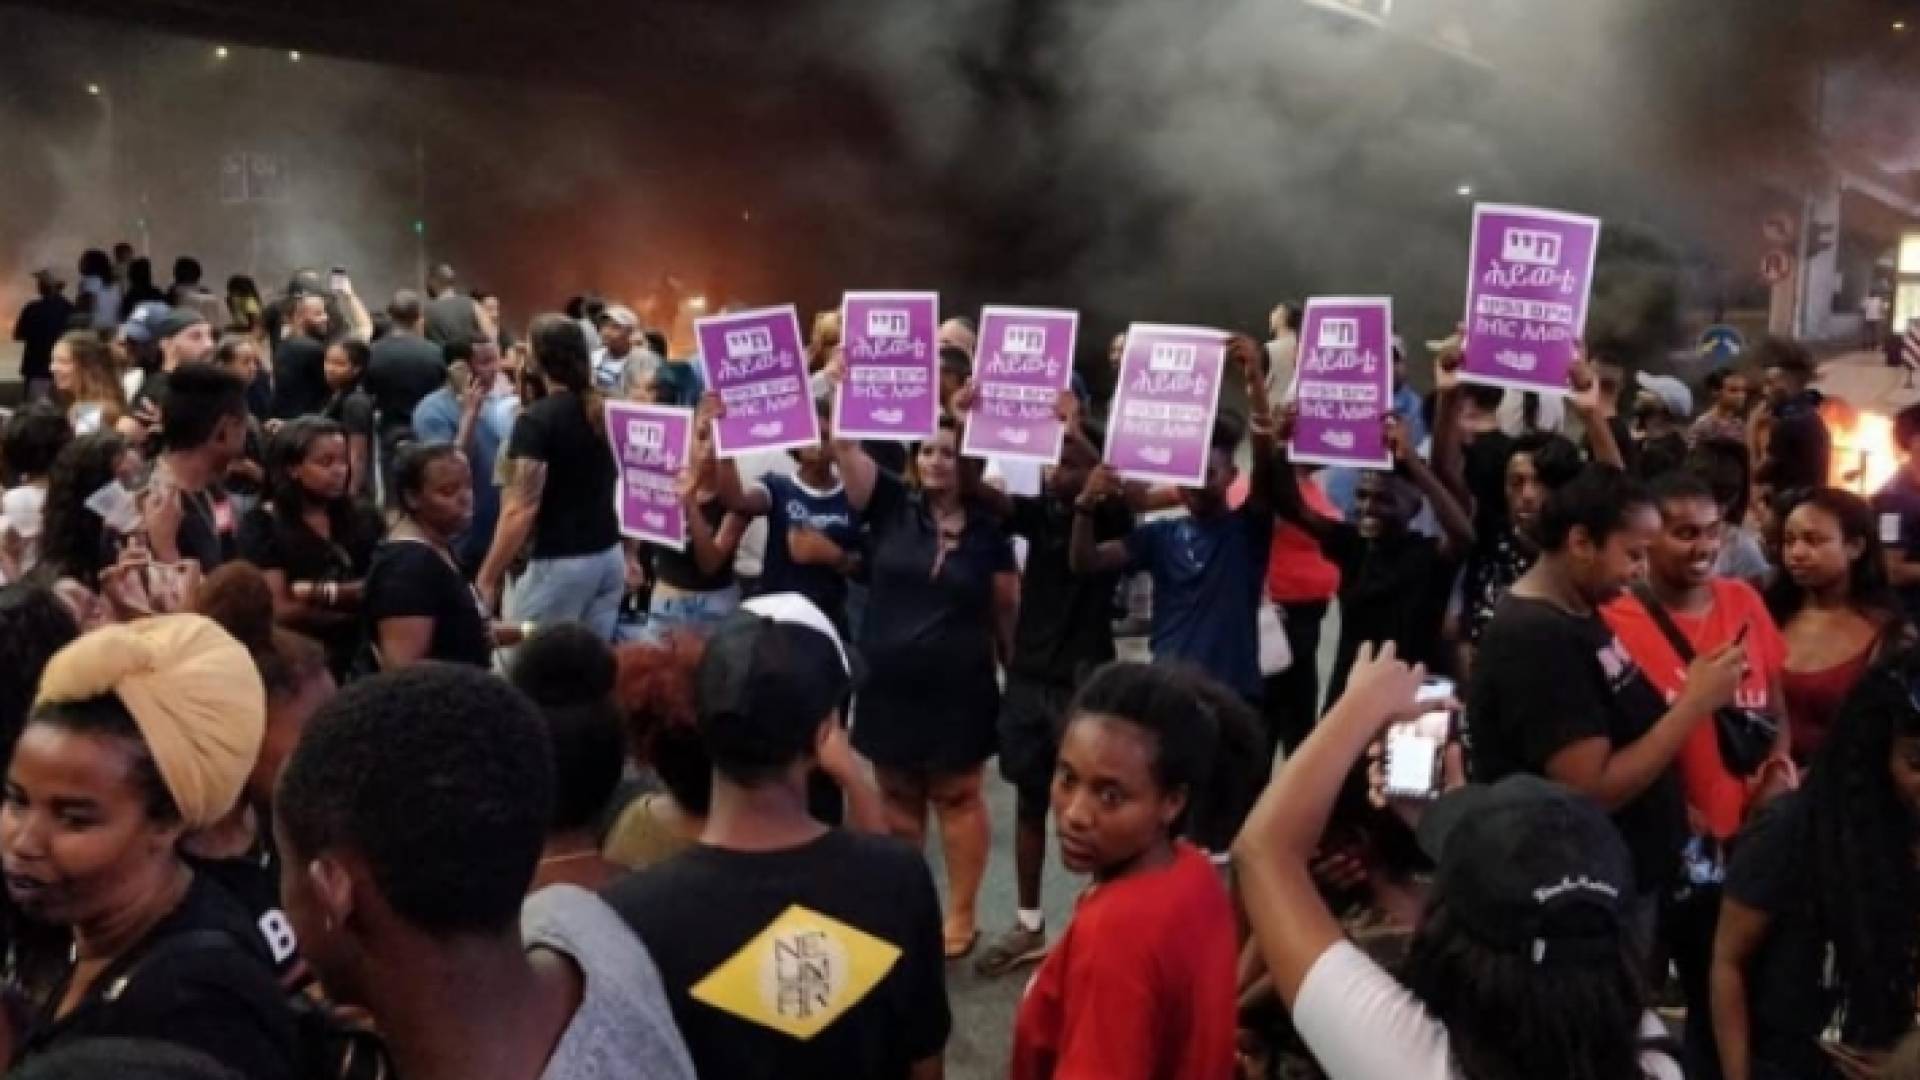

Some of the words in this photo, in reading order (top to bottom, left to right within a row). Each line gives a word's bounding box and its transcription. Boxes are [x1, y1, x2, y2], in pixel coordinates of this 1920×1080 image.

[1510, 232, 1557, 260] חיי
[872, 315, 906, 332] חיי
[729, 332, 768, 350] חיי
[1321, 323, 1354, 344] חיי
